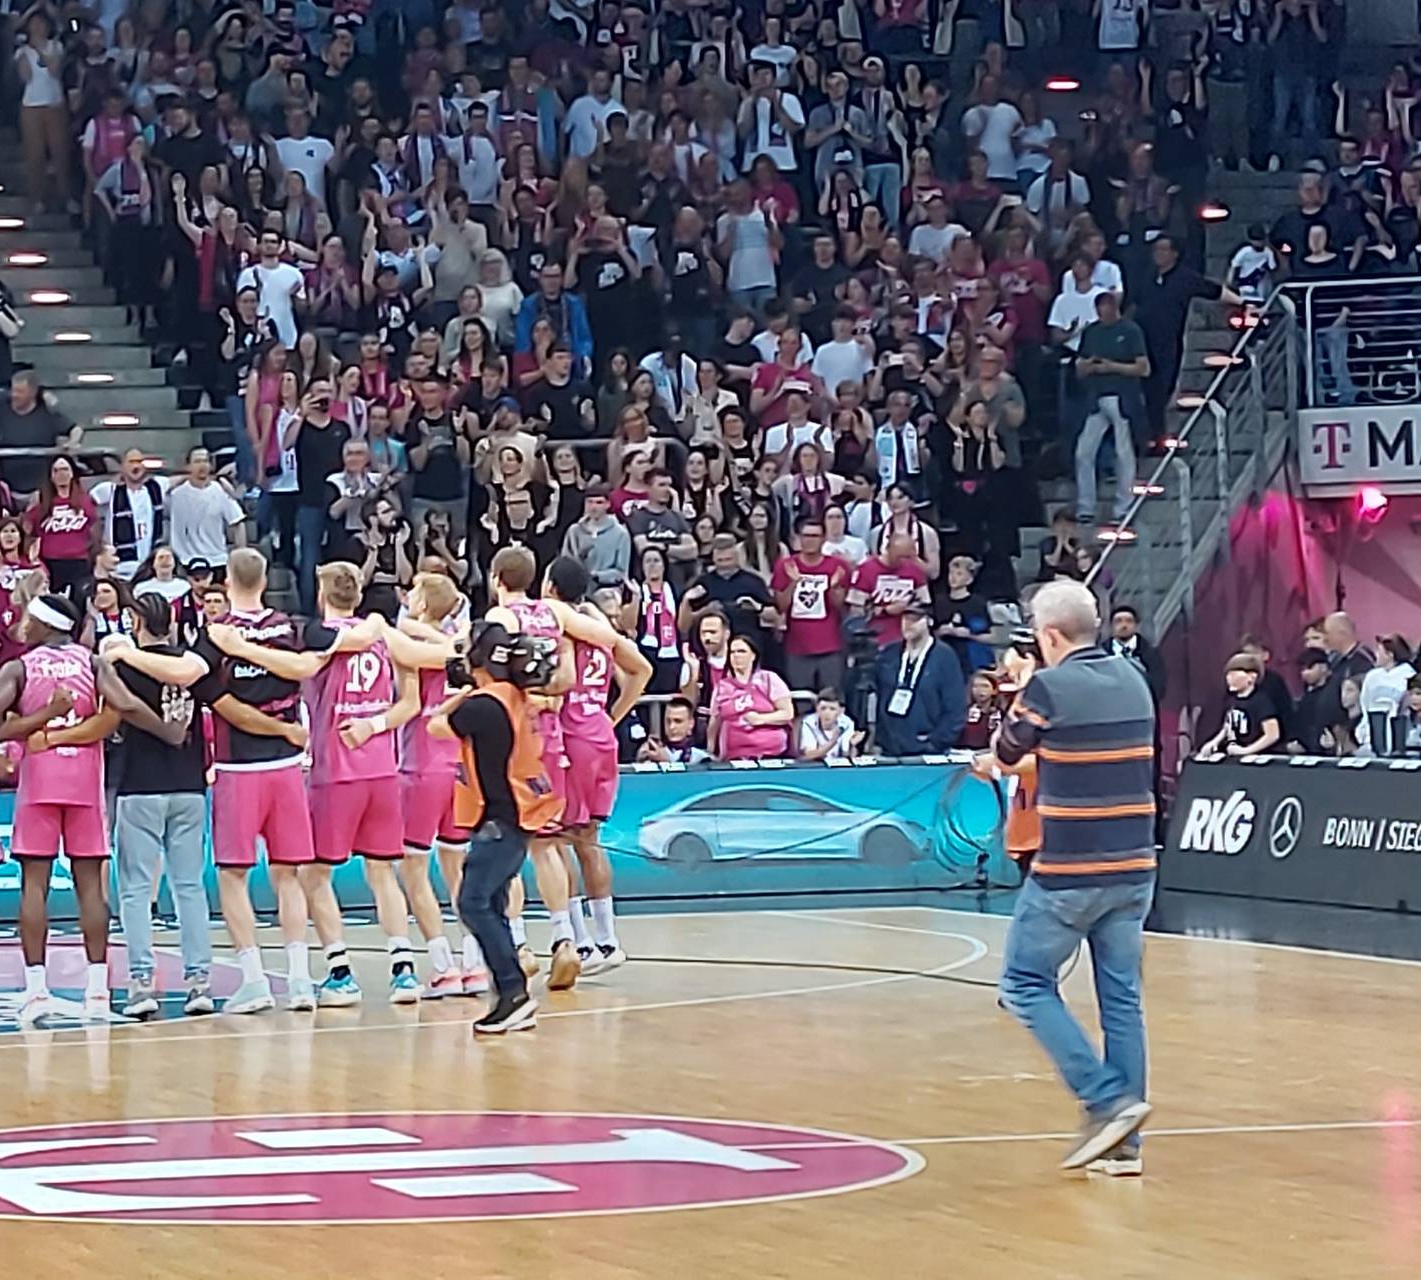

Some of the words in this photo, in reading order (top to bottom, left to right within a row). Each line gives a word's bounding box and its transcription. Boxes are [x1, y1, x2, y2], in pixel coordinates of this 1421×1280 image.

[1368, 420, 1421, 468] M
[346, 652, 381, 692] 19
[1180, 790, 1256, 854] RKG
[1322, 817, 1375, 848] BONN
